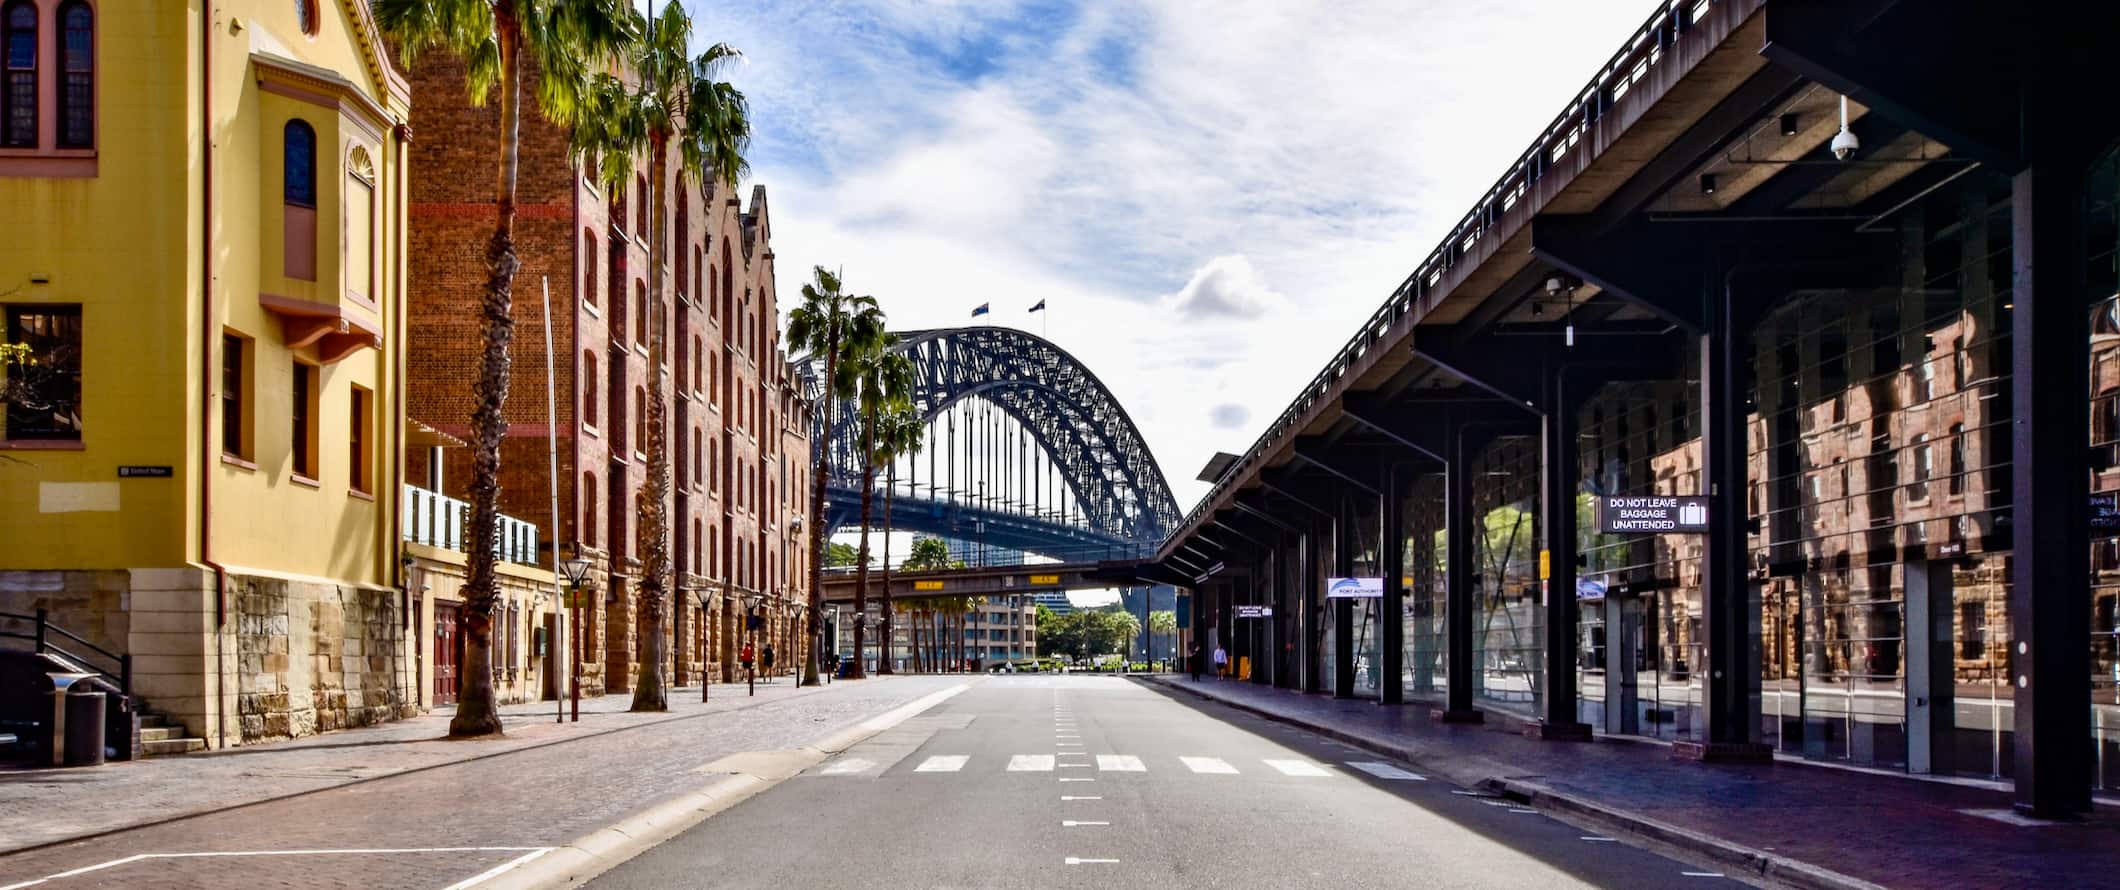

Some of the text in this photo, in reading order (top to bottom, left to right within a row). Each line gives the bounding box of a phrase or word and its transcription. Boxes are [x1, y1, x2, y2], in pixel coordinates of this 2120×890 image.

[1610, 499, 1677, 507] DO NOT LEAVE
[1620, 510, 1667, 518] BAGGAGE
[1612, 520, 1675, 529] UNATTENDED
